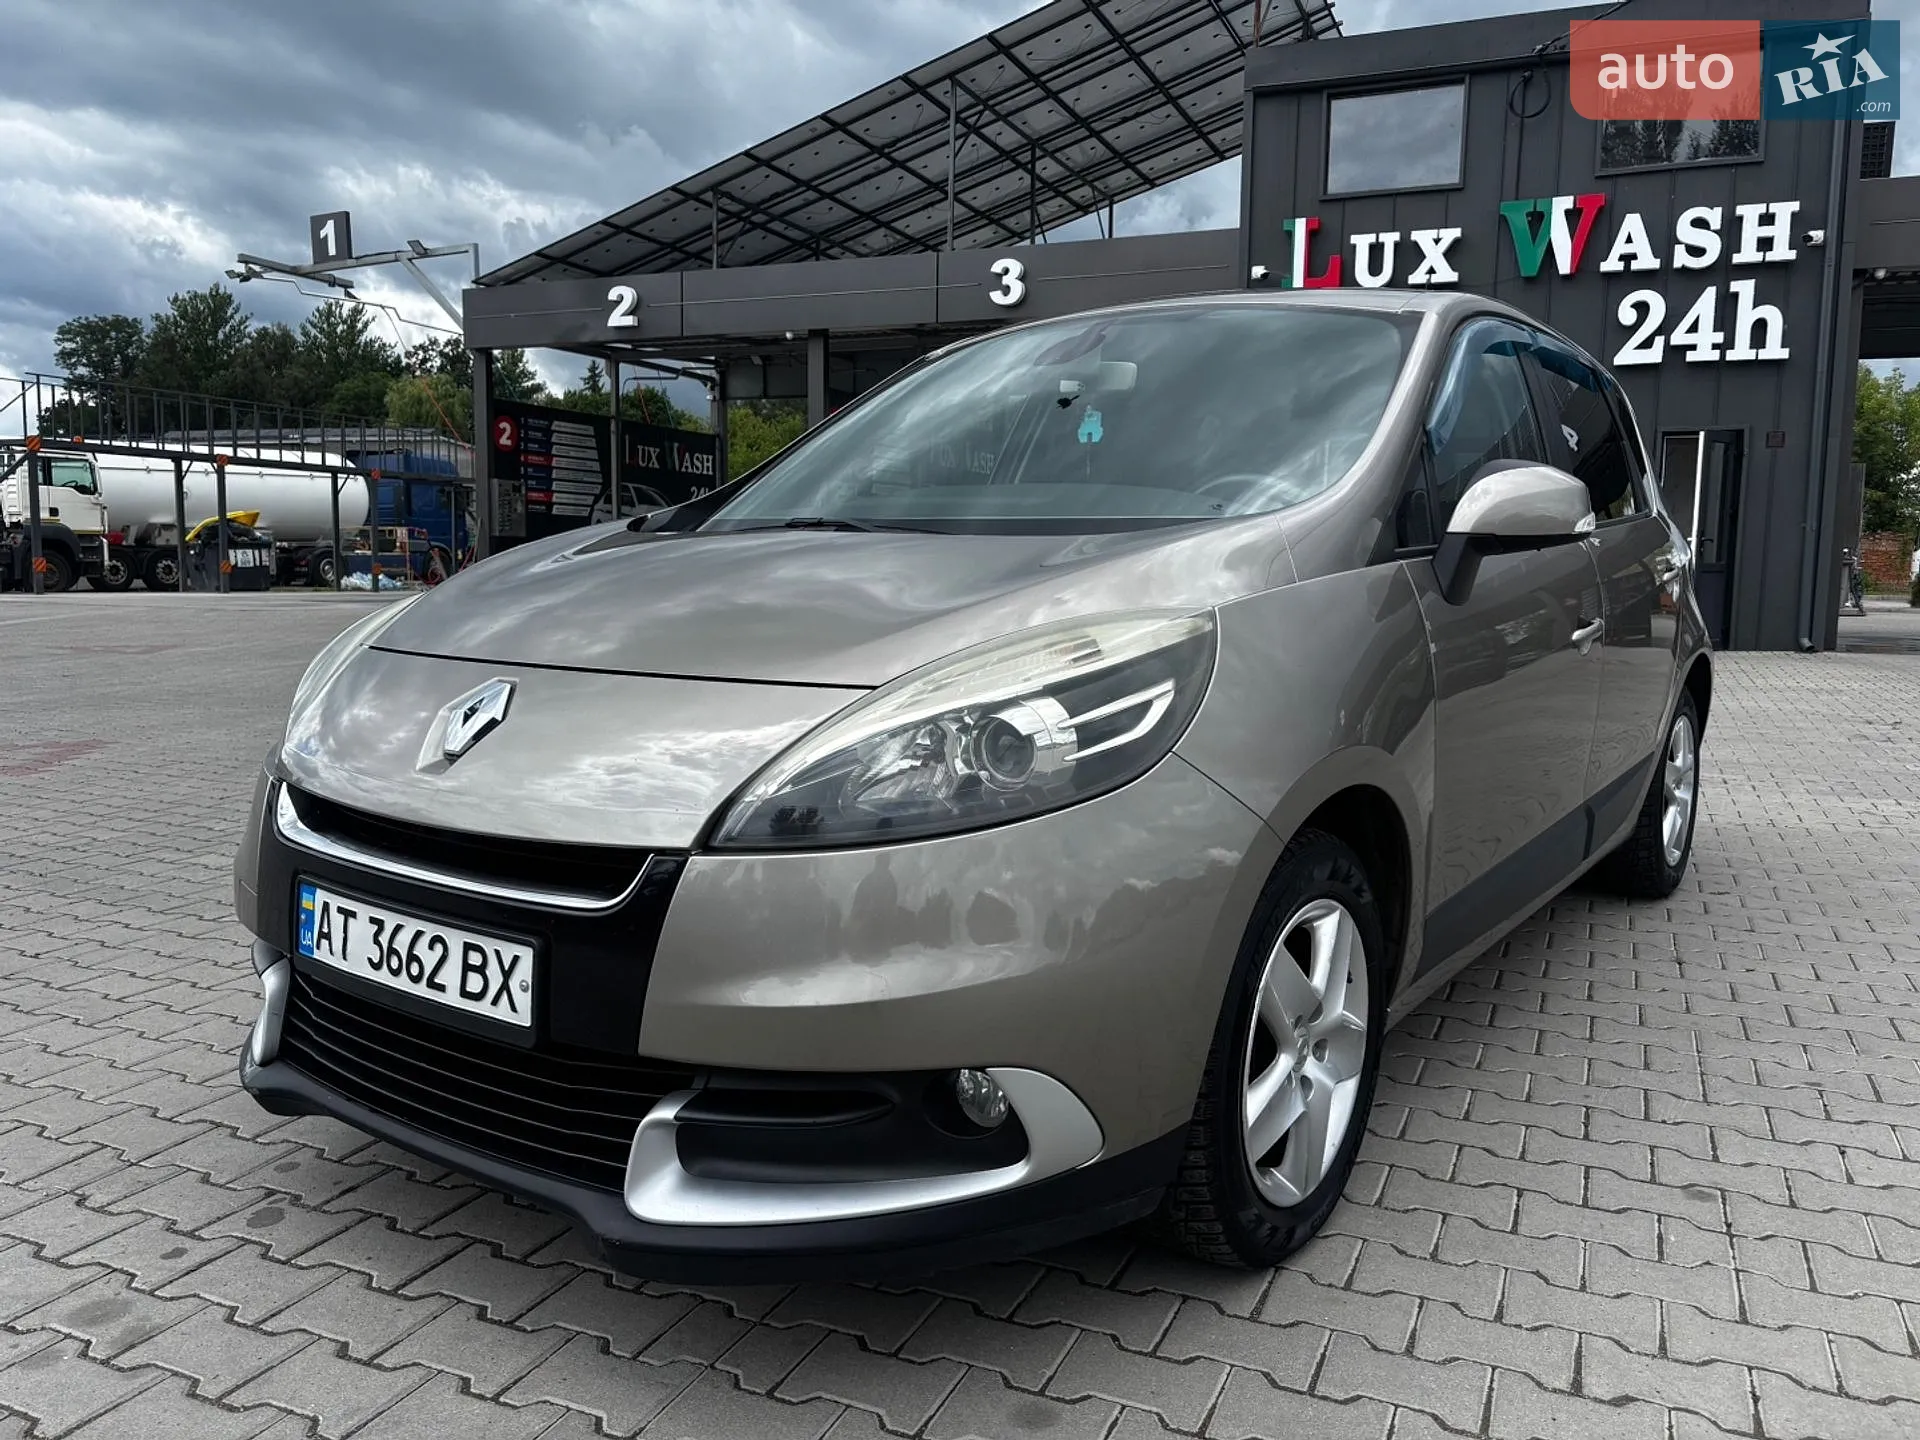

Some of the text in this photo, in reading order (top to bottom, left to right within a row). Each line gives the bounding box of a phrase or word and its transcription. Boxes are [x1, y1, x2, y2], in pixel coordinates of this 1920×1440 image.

[319, 219, 337, 257] 1
[1283, 193, 1800, 288] LUX WASH
[988, 258, 1026, 308] 3
[607, 285, 639, 328] 2
[1613, 278, 1791, 366] 24h
[498, 421, 513, 446] 2
[301, 928, 313, 948] UA
[315, 900, 522, 1014] AT 3662 BX
